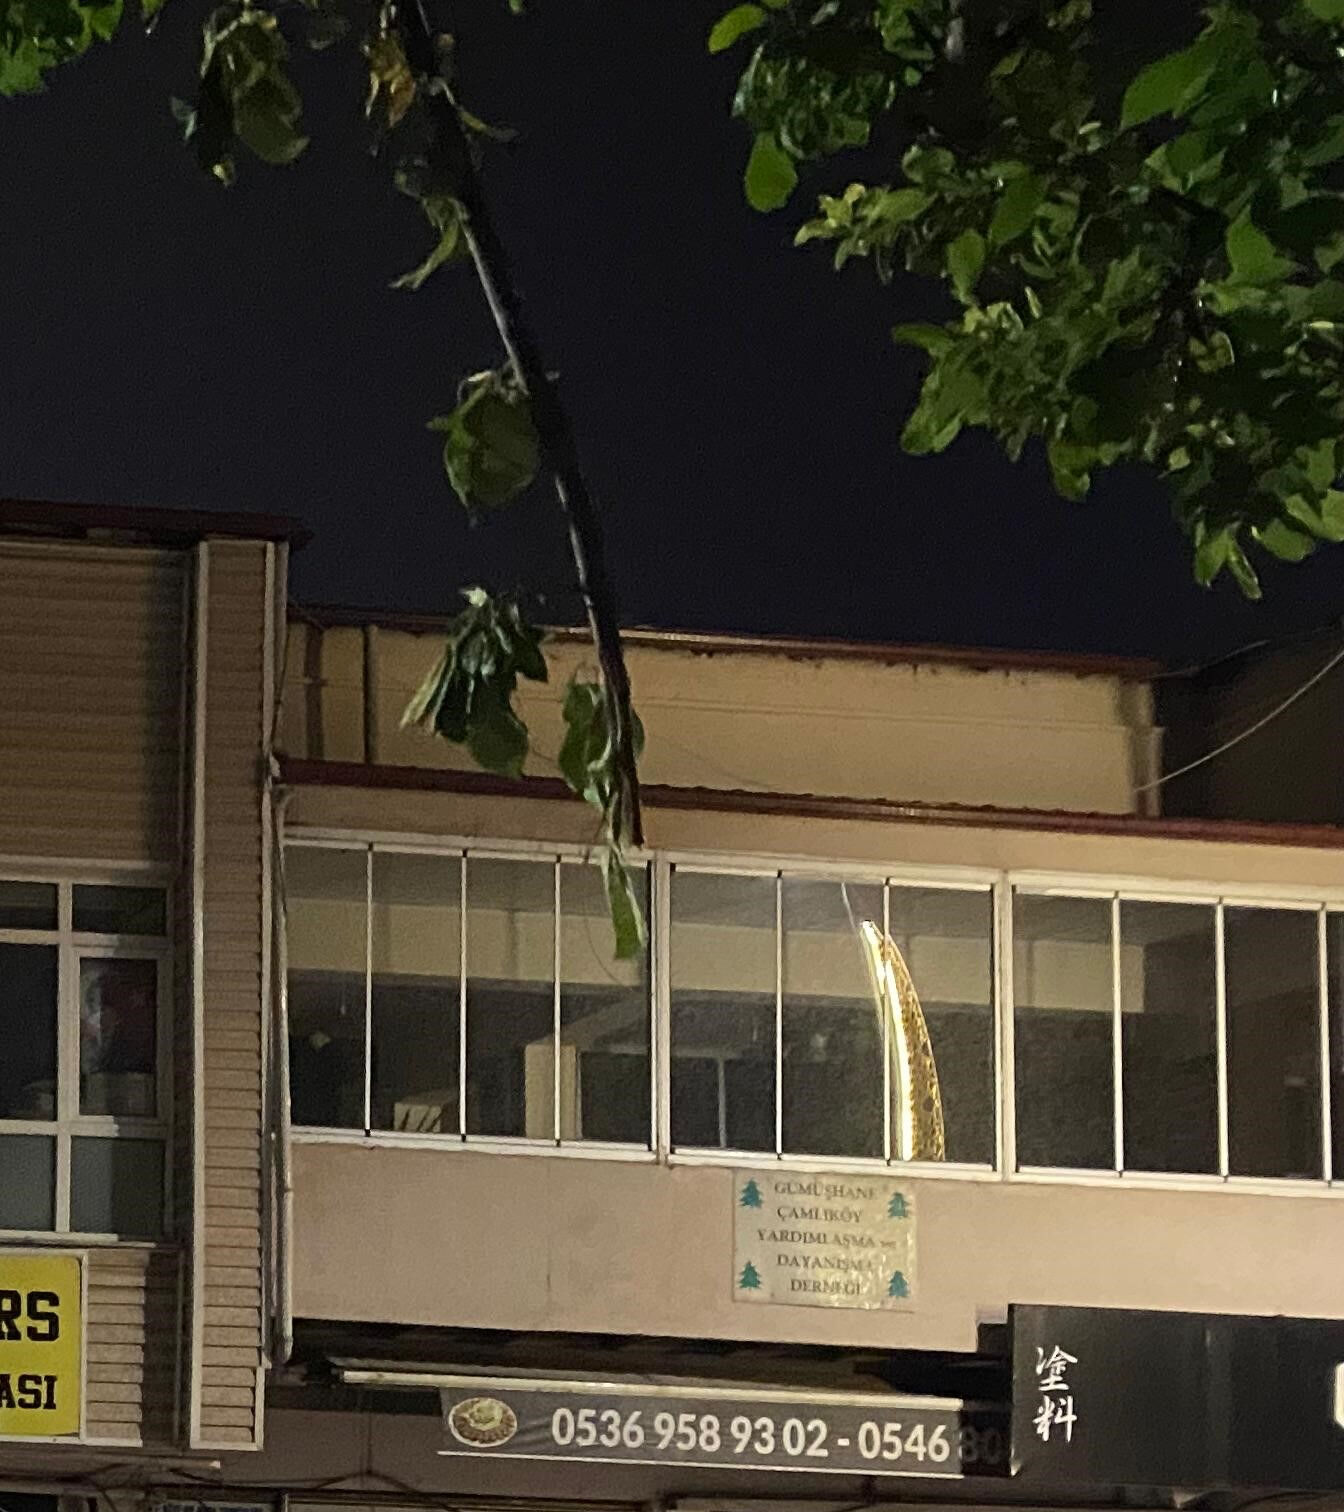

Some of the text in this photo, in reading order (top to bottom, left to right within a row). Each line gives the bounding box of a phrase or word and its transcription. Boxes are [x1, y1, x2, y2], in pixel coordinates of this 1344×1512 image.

[551, 1407, 645, 1448] 0536
[654, 1411, 722, 1452] 958
[730, 1415, 775, 1455] 93
[782, 1418, 829, 1458] 02
[858, 1420, 950, 1463] 0546
